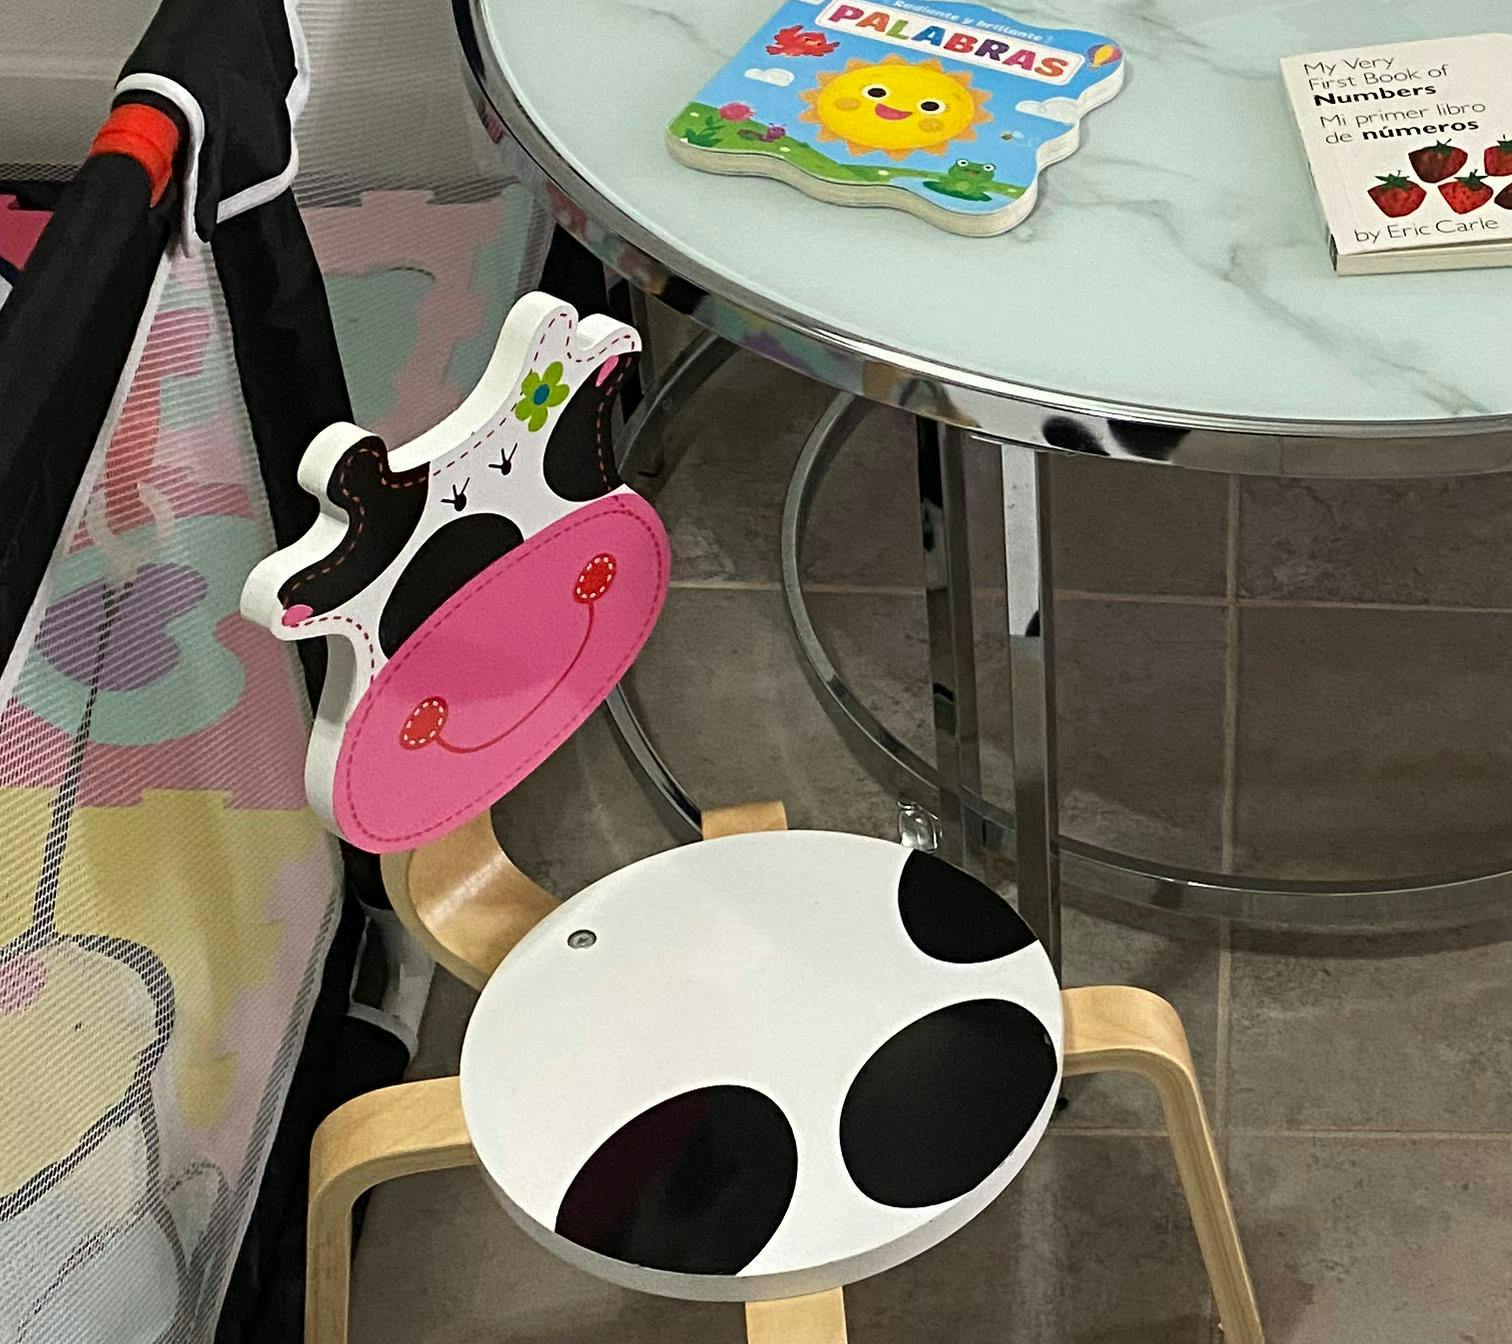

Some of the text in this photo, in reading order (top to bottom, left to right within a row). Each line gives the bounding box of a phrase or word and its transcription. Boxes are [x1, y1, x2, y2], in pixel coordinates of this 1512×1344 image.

[893, 0, 1044, 42] Radiante y brillante
[829, 4, 1069, 81] PALABRAS
[1304, 57, 1395, 76] My Very
[1308, 63, 1449, 91] First Book of
[1314, 83, 1437, 106] Numbers
[1320, 101, 1486, 128] Mi primer libro
[1325, 119, 1479, 144] de números
[1354, 217, 1500, 243] by Eric Carle
